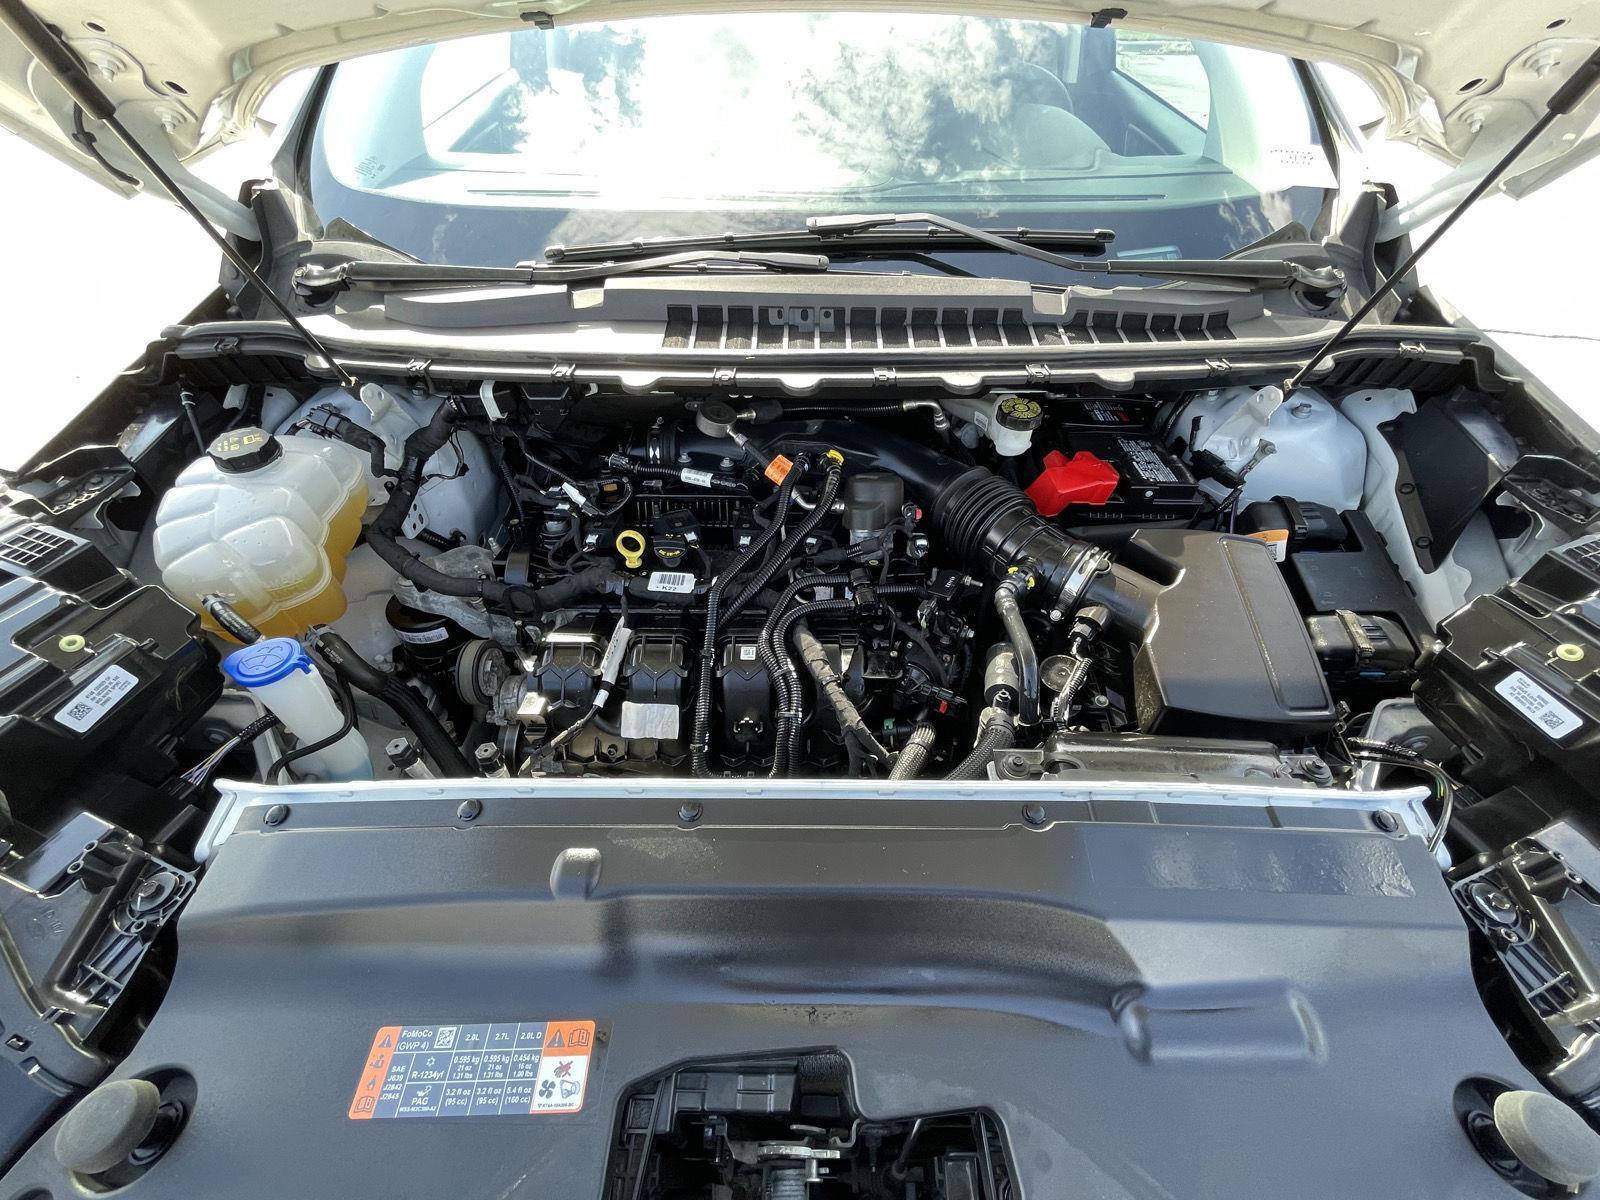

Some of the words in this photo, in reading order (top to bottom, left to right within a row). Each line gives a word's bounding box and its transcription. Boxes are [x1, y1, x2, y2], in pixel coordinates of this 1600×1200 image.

[402, 1030, 432, 1038] FoMoCo
[396, 1041, 419, 1052] (GWP
[421, 1041, 429, 1051] 4)
[454, 1056, 471, 1064] 0.595
[471, 1056, 480, 1064] kg
[484, 1055, 501, 1063] 0.595
[501, 1055, 510, 1064] kg
[532, 1054, 540, 1063] kg
[412, 1071, 444, 1080] R-1234yf
[411, 1097, 428, 1105] PAG
[445, 1098, 456, 1106] (95
[457, 1098, 467, 1106] cc)
[477, 1098, 487, 1106] (95
[488, 1097, 498, 1105] cc)
[520, 1096, 531, 1104] cc)
